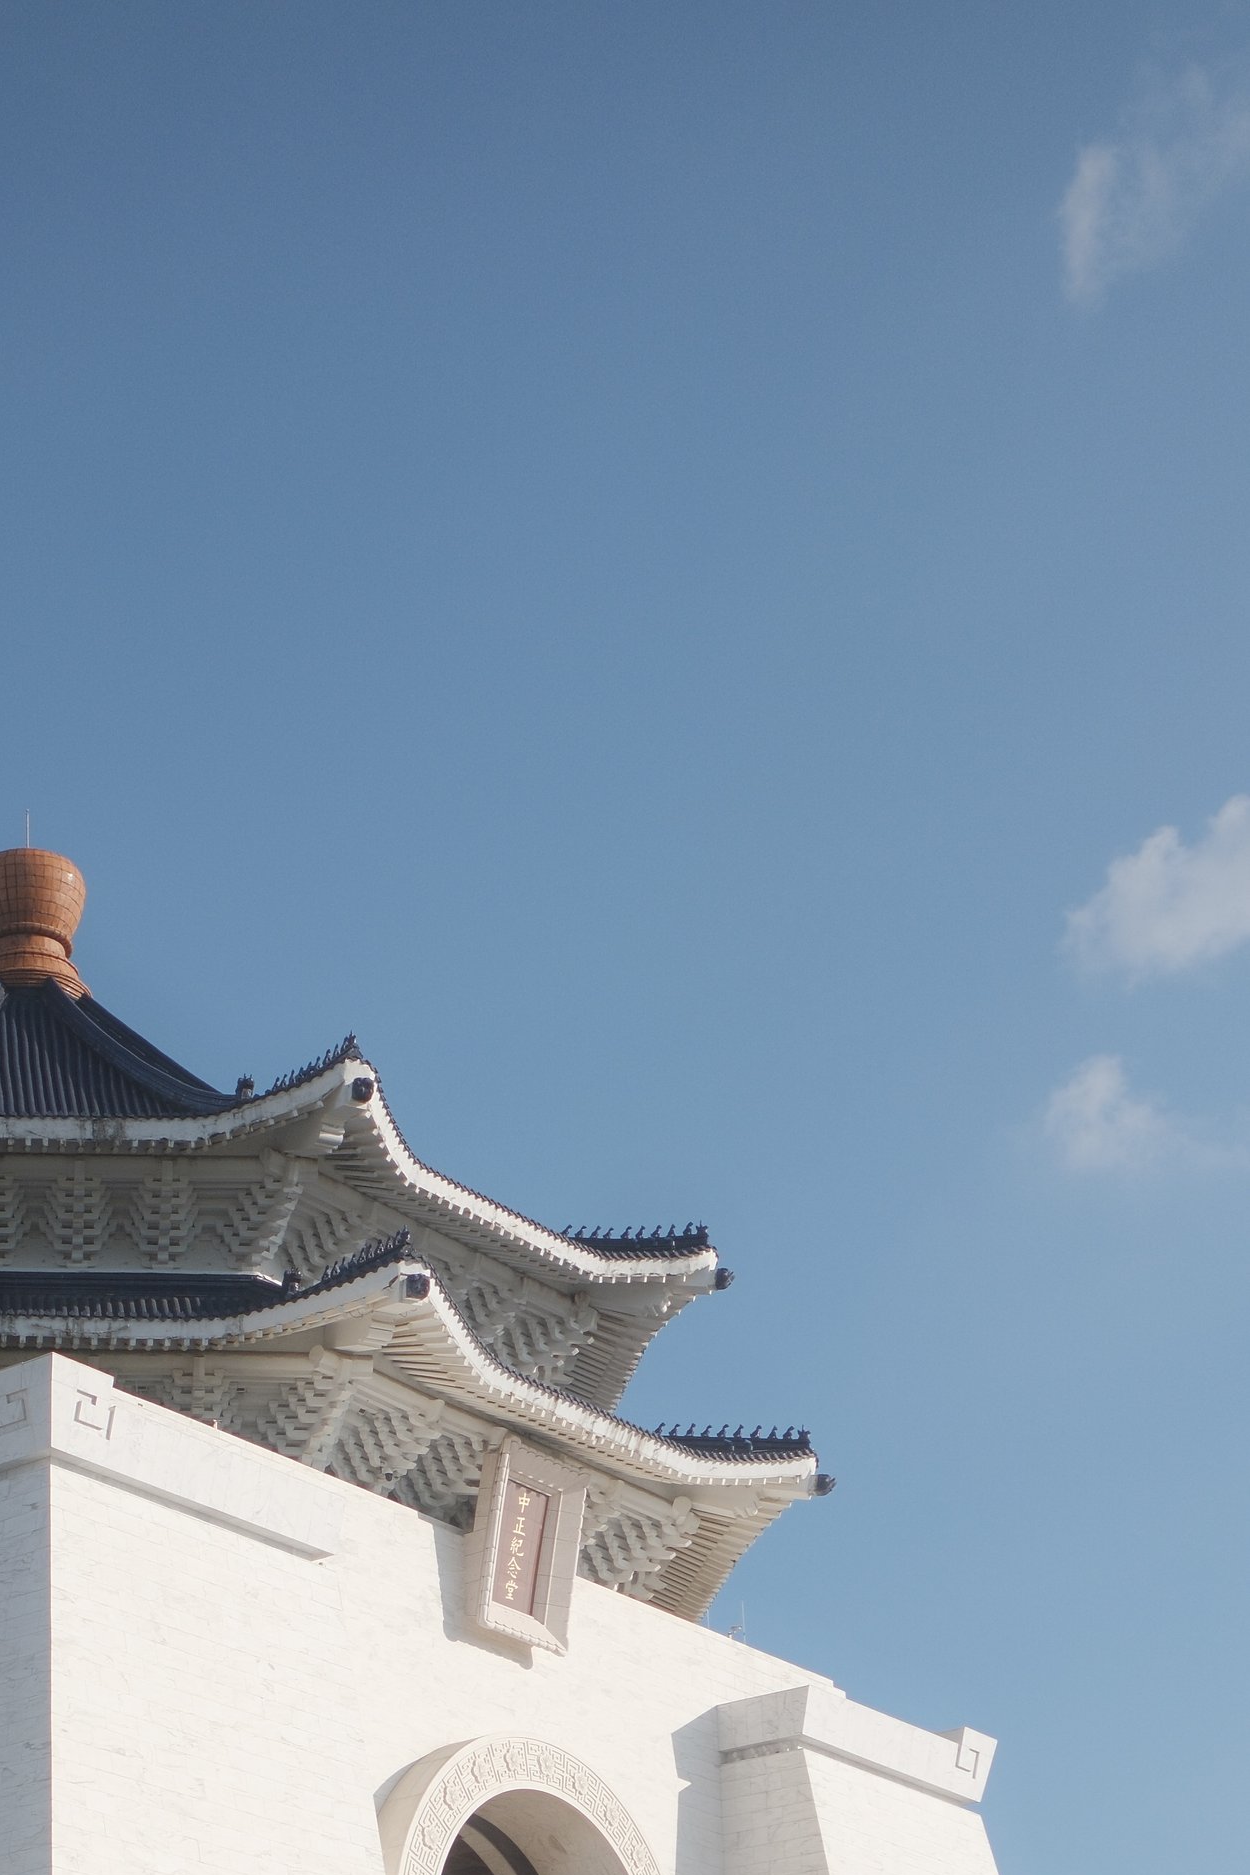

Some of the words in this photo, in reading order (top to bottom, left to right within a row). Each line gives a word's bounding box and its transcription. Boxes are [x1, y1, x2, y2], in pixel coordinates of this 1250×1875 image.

[505, 1492, 531, 1601] 中正紀念堂
